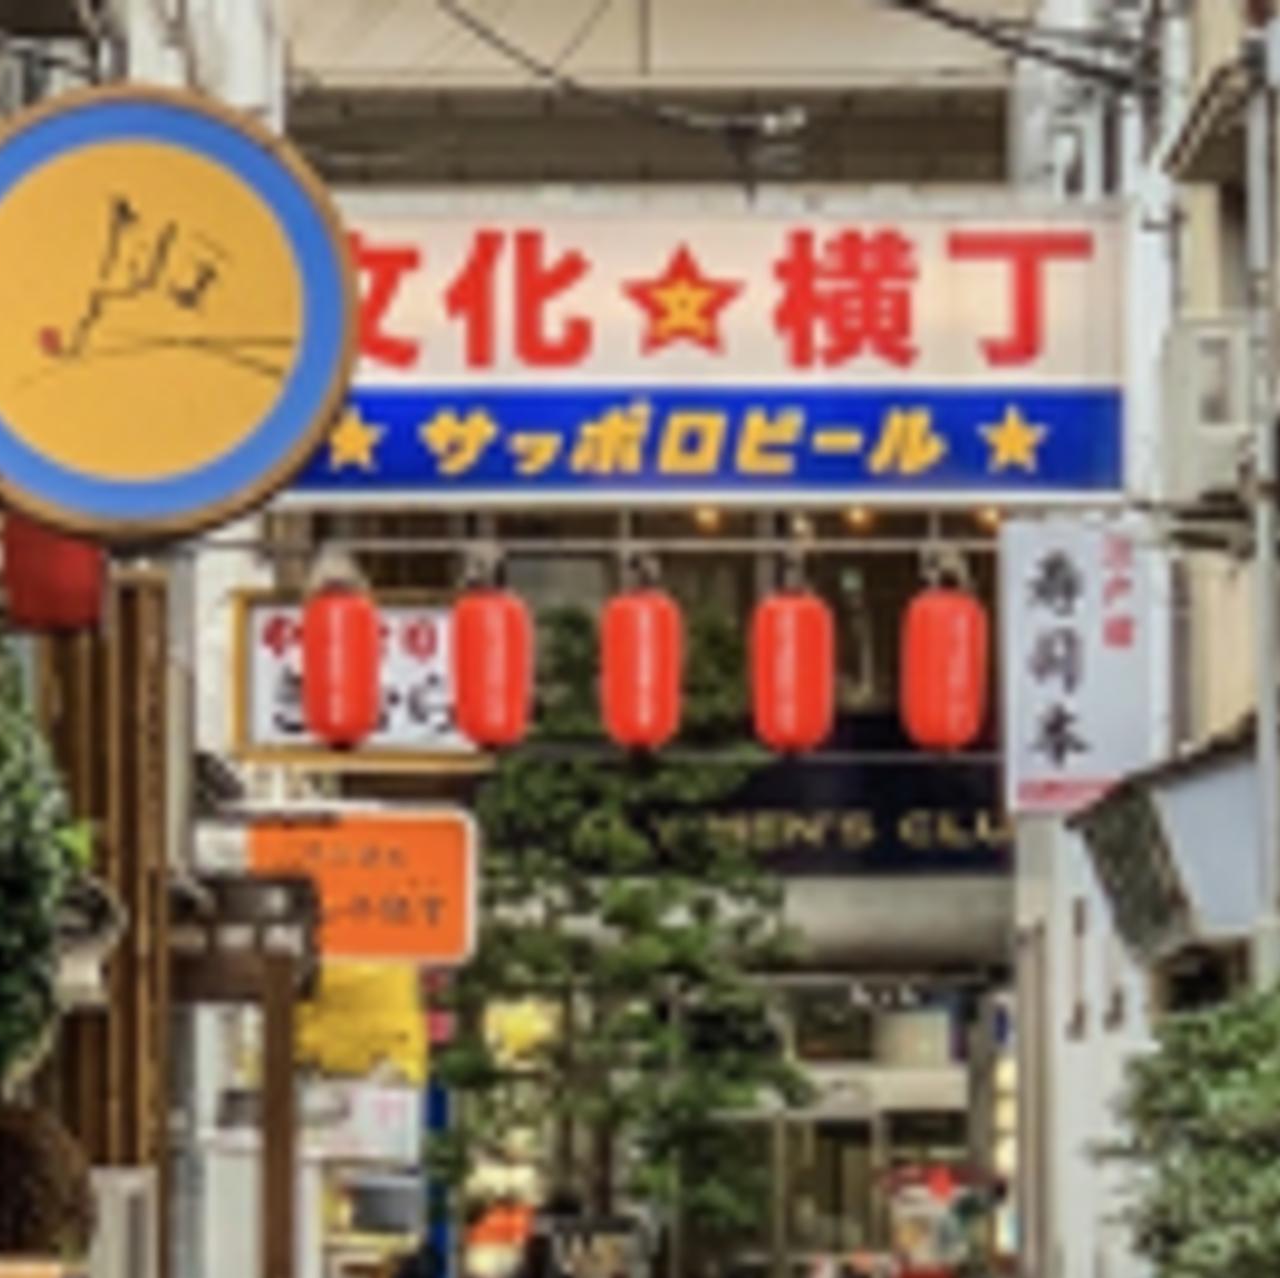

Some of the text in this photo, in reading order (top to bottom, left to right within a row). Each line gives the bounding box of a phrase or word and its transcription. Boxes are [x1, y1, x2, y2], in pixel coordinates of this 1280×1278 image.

[773, 228, 1095, 369] 横丁
[419, 398, 947, 475] サッポロビール
